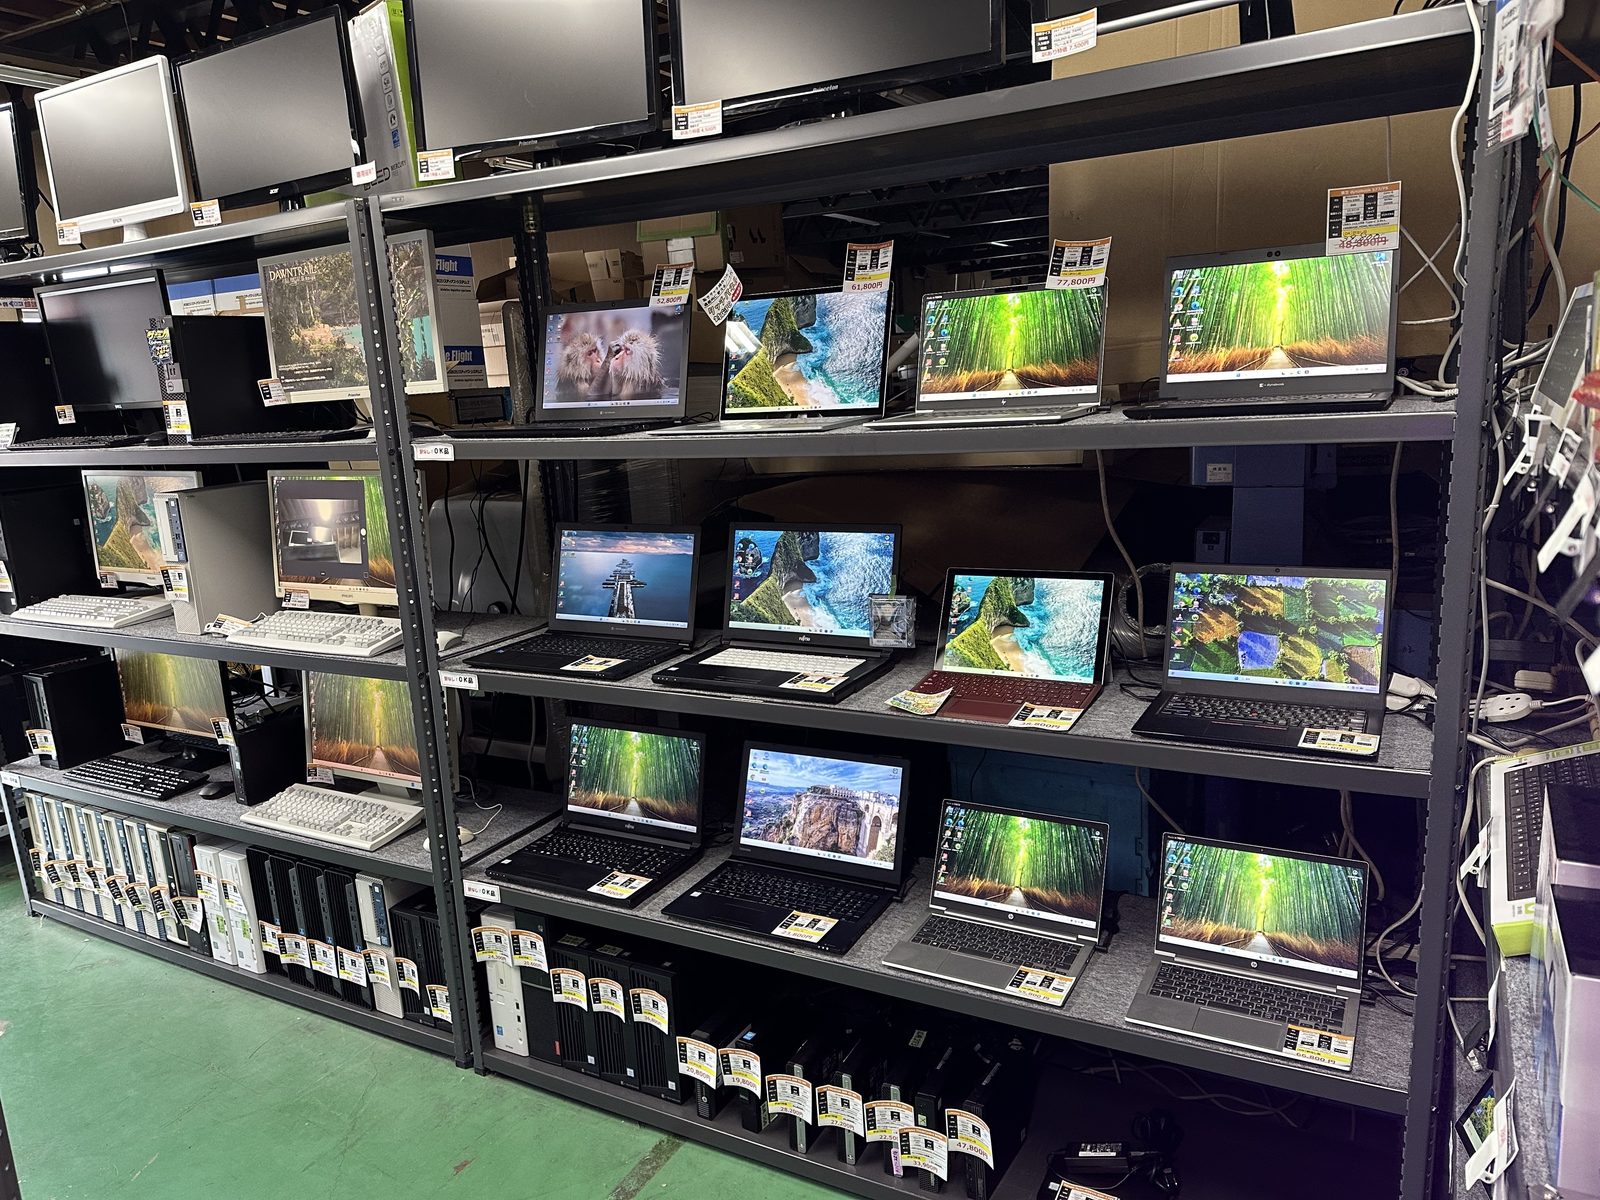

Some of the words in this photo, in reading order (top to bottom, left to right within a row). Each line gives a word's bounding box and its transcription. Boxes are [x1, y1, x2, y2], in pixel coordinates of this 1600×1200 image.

[269, 265, 317, 281] DAWNTRAIL
[851, 281, 883, 291] 61,800円
[1056, 277, 1096, 287] 77,800円
[956, 1141, 989, 1160] 47,800円
